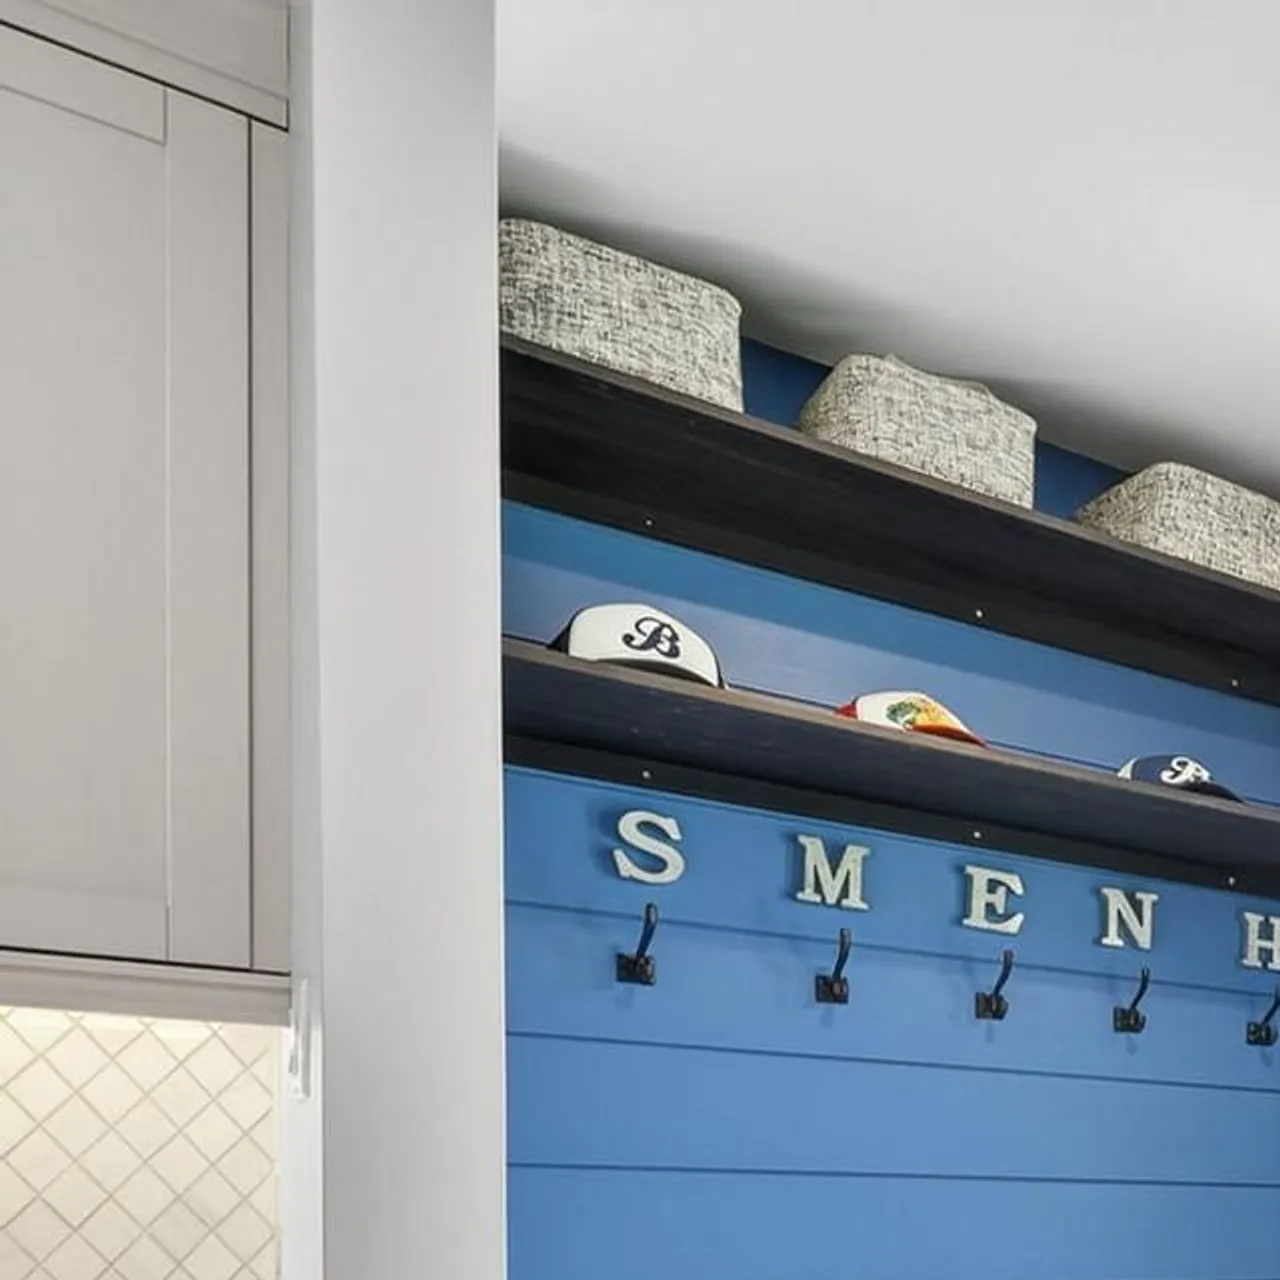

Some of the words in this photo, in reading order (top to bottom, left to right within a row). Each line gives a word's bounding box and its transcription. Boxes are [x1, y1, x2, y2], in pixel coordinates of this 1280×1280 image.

[622, 616, 681, 659] B
[612, 810, 686, 884] S
[796, 834, 871, 911] M
[962, 864, 1026, 935] E
[1100, 886, 1159, 951] N
